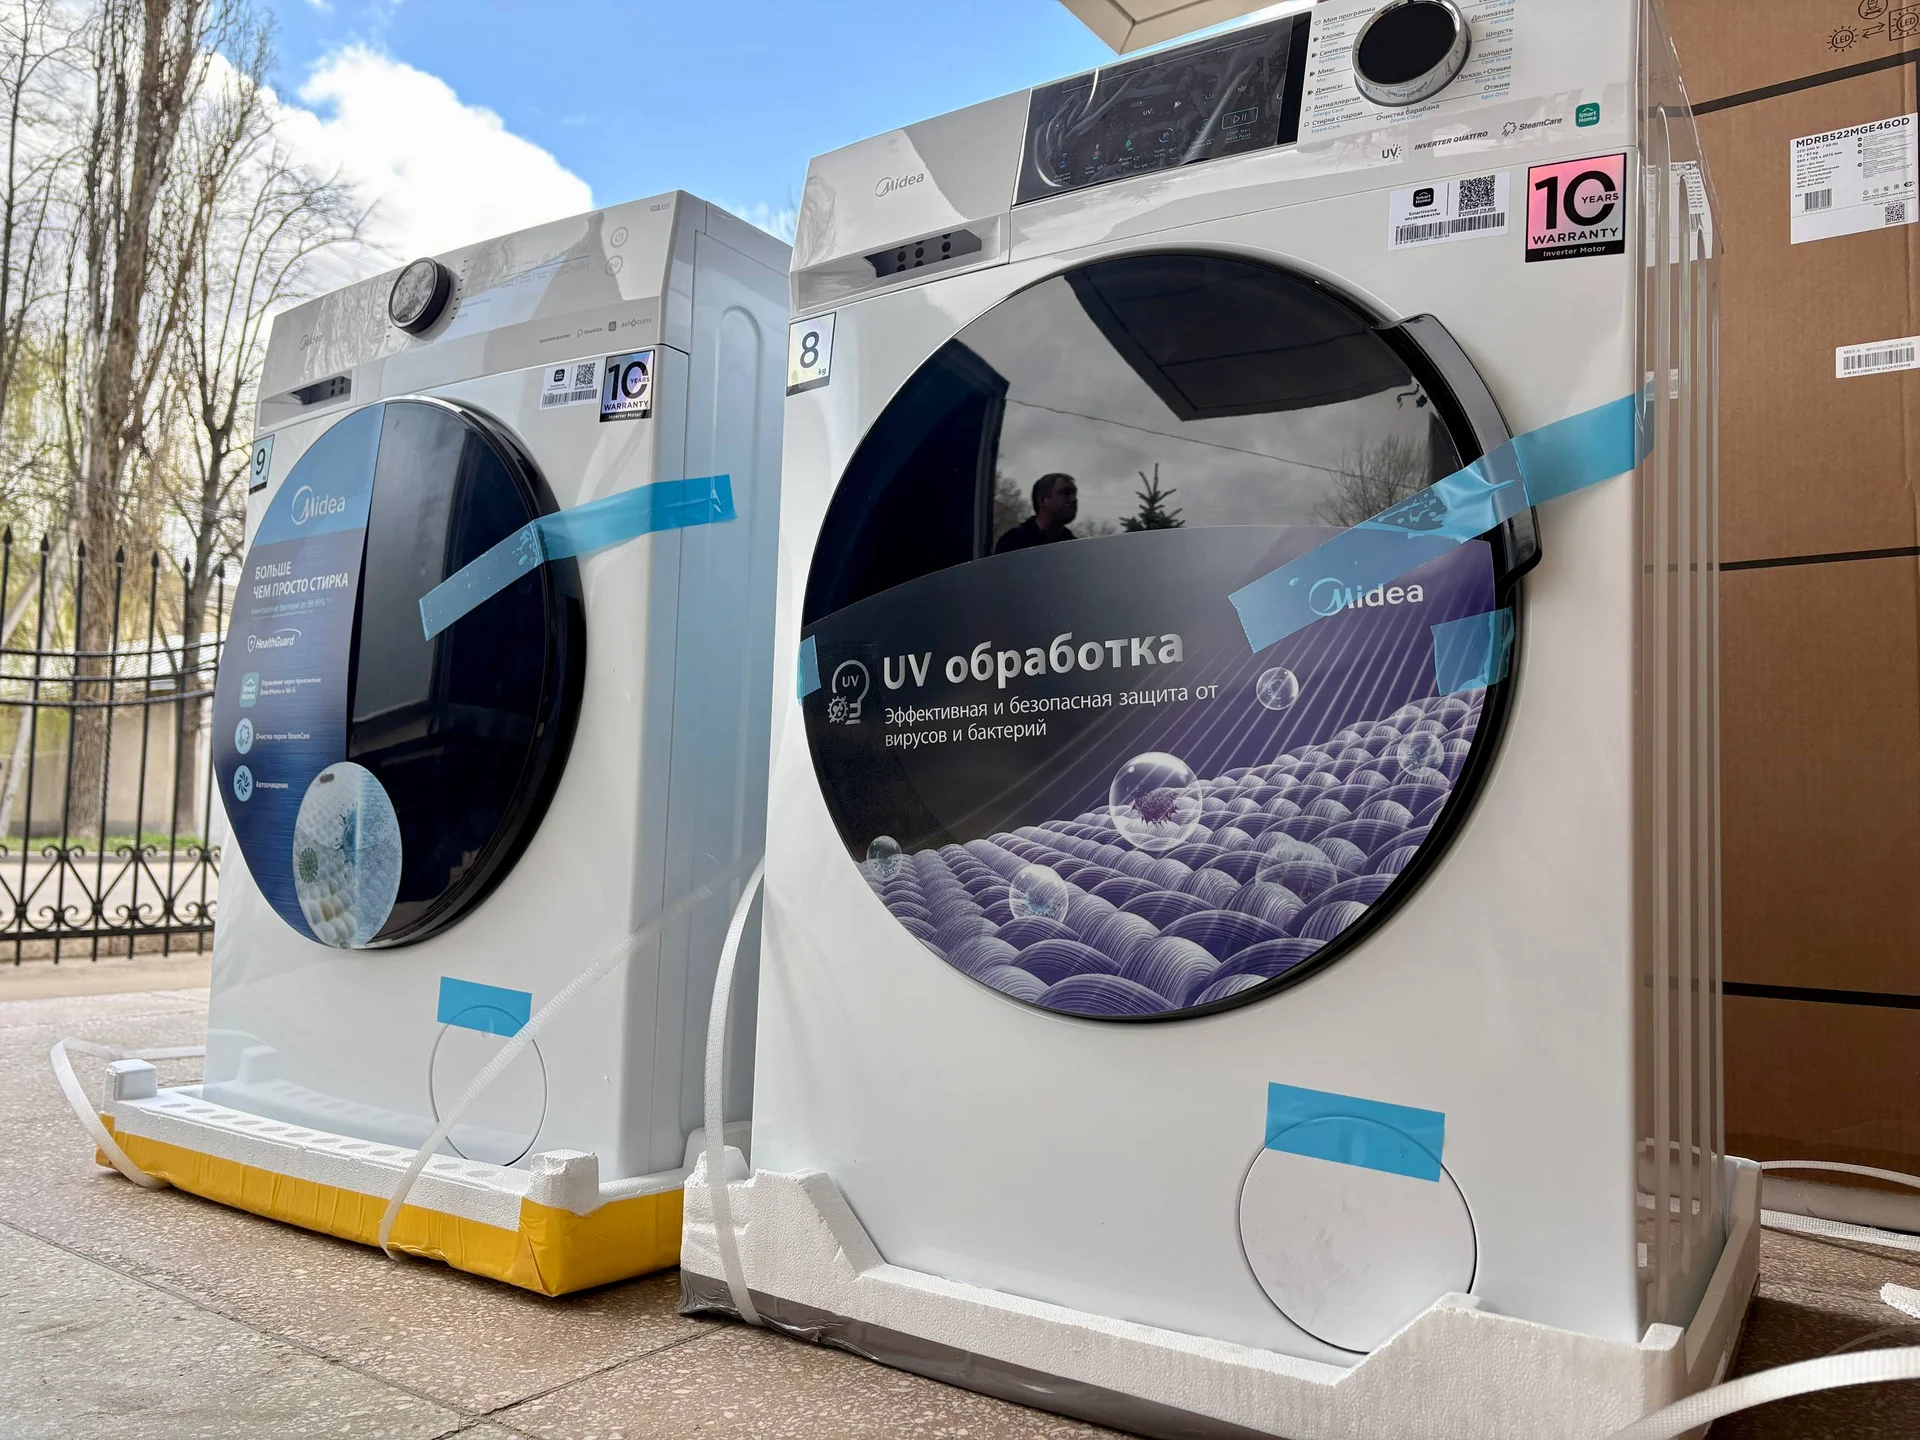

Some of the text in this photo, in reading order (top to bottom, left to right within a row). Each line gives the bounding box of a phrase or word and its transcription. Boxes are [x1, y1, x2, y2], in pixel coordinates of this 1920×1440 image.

[1323, 6, 1376, 24] Моя программа
[1471, 8, 1514, 22] Деликатная
[1900, 17, 1916, 28] LED
[1321, 31, 1345, 41] Хлопок
[1486, 28, 1513, 38] Шерсть
[1835, 34, 1851, 45] LED
[1320, 45, 1353, 56] Синтетика
[1478, 47, 1512, 59] Холодная
[1318, 67, 1336, 75] Микс
[1315, 84, 1343, 94] Джинсы
[1484, 82, 1510, 91] Отжим
[1314, 96, 1361, 110] Антиаллергия
[1312, 117, 1335, 126] Стирка
[1340, 111, 1363, 120] паром
[1376, 104, 1440, 121] Очистка барабана
[1578, 110, 1596, 118] Smart
[1518, 117, 1563, 131] SteamCare
[1414, 131, 1488, 150] INVERTER QUATTRO
[1382, 148, 1398, 159] UV
[874, 173, 925, 197] Midea
[1534, 170, 1616, 230] 10
[1582, 193, 1619, 204] YEARS
[1409, 208, 1437, 216] SmartHome
[1532, 227, 1619, 245] WARRANTY
[1543, 244, 1606, 258] Inverter Motor
[300, 334, 324, 350] Midea
[800, 331, 820, 368] 8
[608, 361, 648, 400] 10
[604, 400, 648, 411] WARRANTY
[256, 448, 266, 475] 9
[292, 485, 346, 525] Midea
[255, 561, 292, 580] БОЛЬШЕ
[253, 572, 349, 600] ЧЕМ ПРОСТО СТИРКА
[1308, 577, 1424, 616] Midea
[256, 635, 294, 649] HealthGuard
[883, 632, 1184, 690] UV обработка
[243, 684, 256, 692] Smart
[842, 675, 860, 688] UV
[884, 684, 1218, 726] Эффективная и безопасная защита от
[287, 732, 310, 740] SteamCare
[884, 720, 1047, 750] вирусов и бактерий
